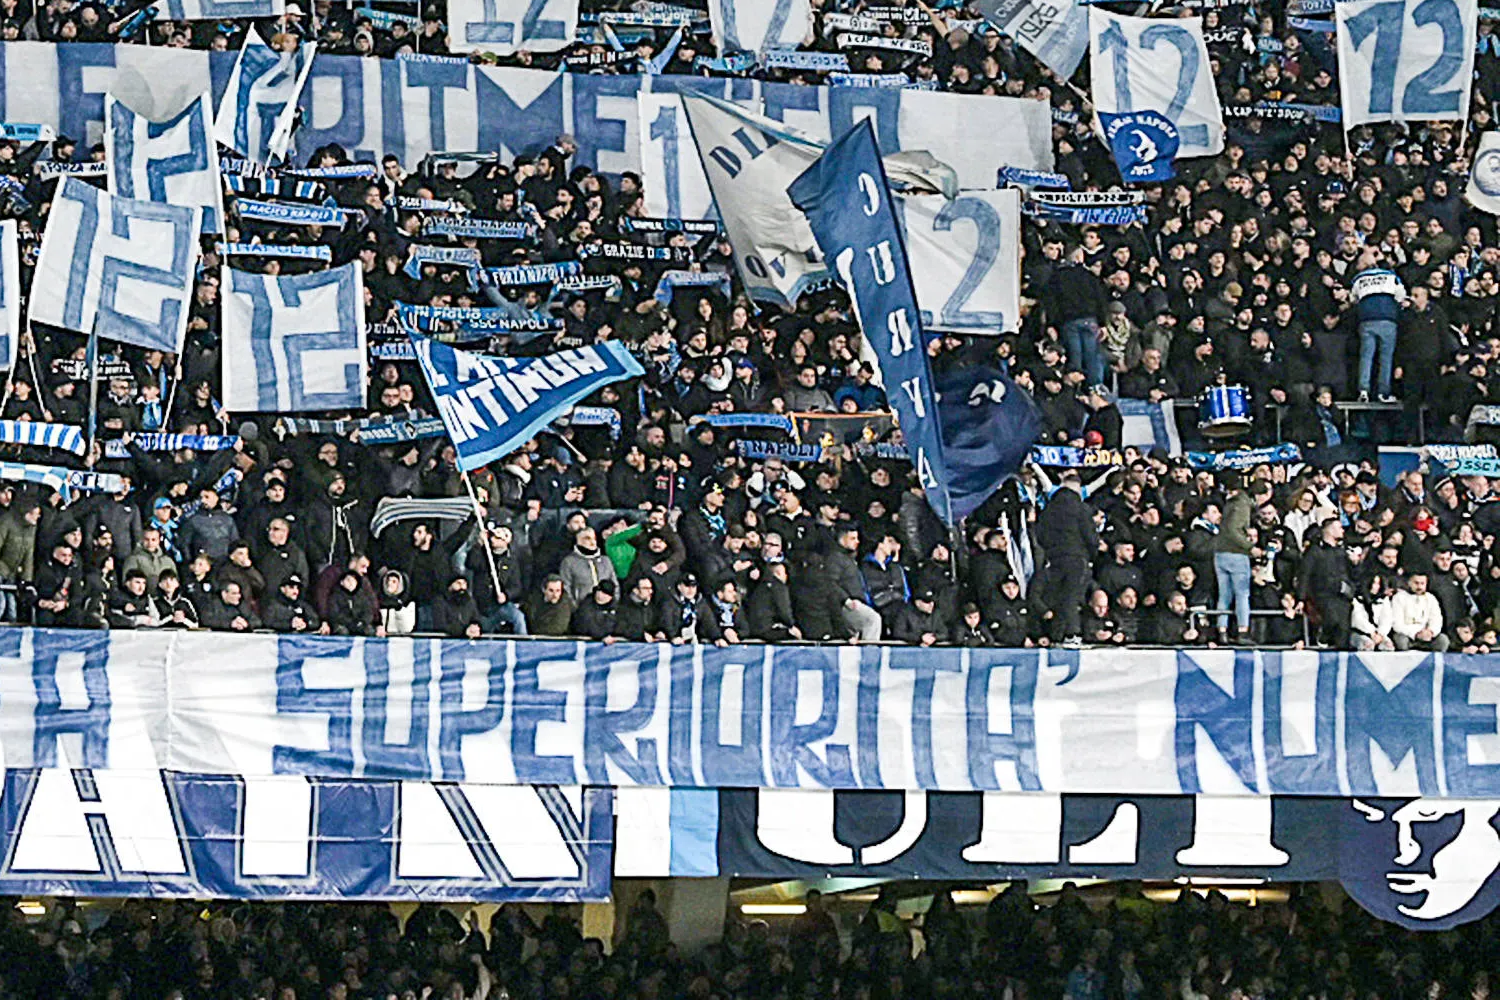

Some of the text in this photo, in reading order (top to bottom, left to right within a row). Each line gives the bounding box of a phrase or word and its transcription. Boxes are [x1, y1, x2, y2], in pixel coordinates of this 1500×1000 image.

[1099, 18, 1209, 148] 12
[61, 180, 193, 353] 12
[603, 244, 645, 258] GRAZIE
[231, 265, 365, 412] 12
[500, 317, 550, 331] NAPOLI
[752, 443, 816, 459] NAPOLI
